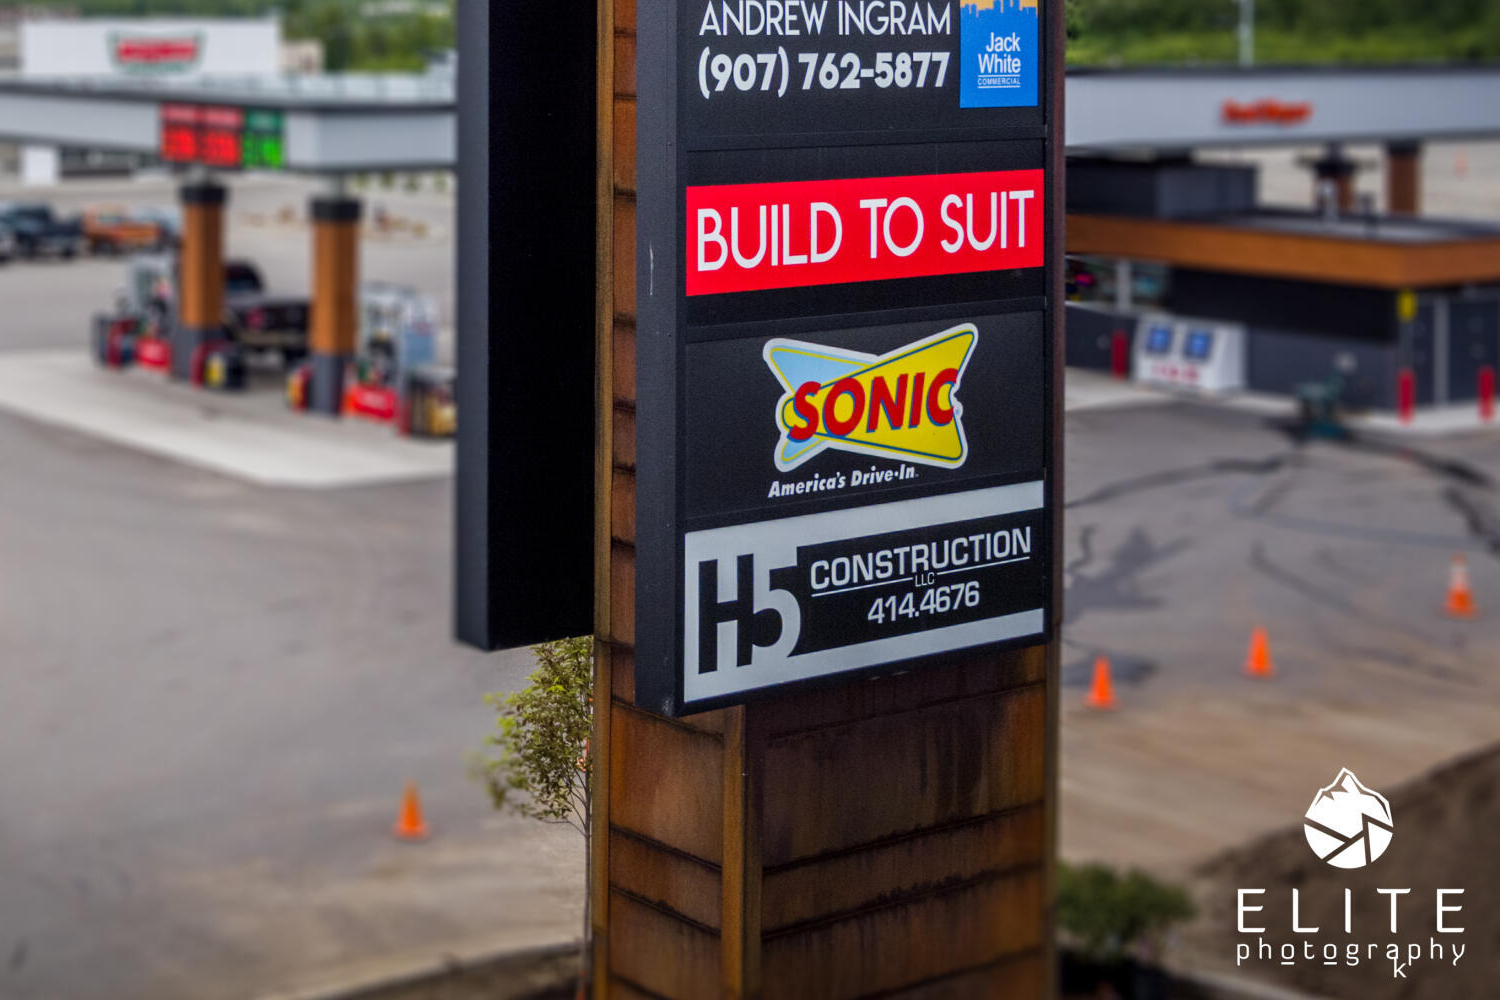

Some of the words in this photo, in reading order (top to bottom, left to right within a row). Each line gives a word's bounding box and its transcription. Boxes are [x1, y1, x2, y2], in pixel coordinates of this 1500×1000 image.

[699, 0, 828, 36] ANDREW
[838, 0, 951, 36] INGRAM
[977, 53, 1022, 74] White
[986, 32, 1021, 52] Jack
[699, 46, 790, 100] (907)
[799, 51, 951, 91] 762-5877
[697, 201, 843, 272] BUILD
[860, 196, 925, 259] TO
[940, 190, 1035, 254] SUIT
[789, 368, 959, 442] SONIC
[767, 471, 847, 499] America's
[810, 526, 1032, 591] CONSTRUCTION
[915, 572, 936, 586] LLC
[698, 546, 800, 675] H5
[867, 581, 981, 625] 414.4676
